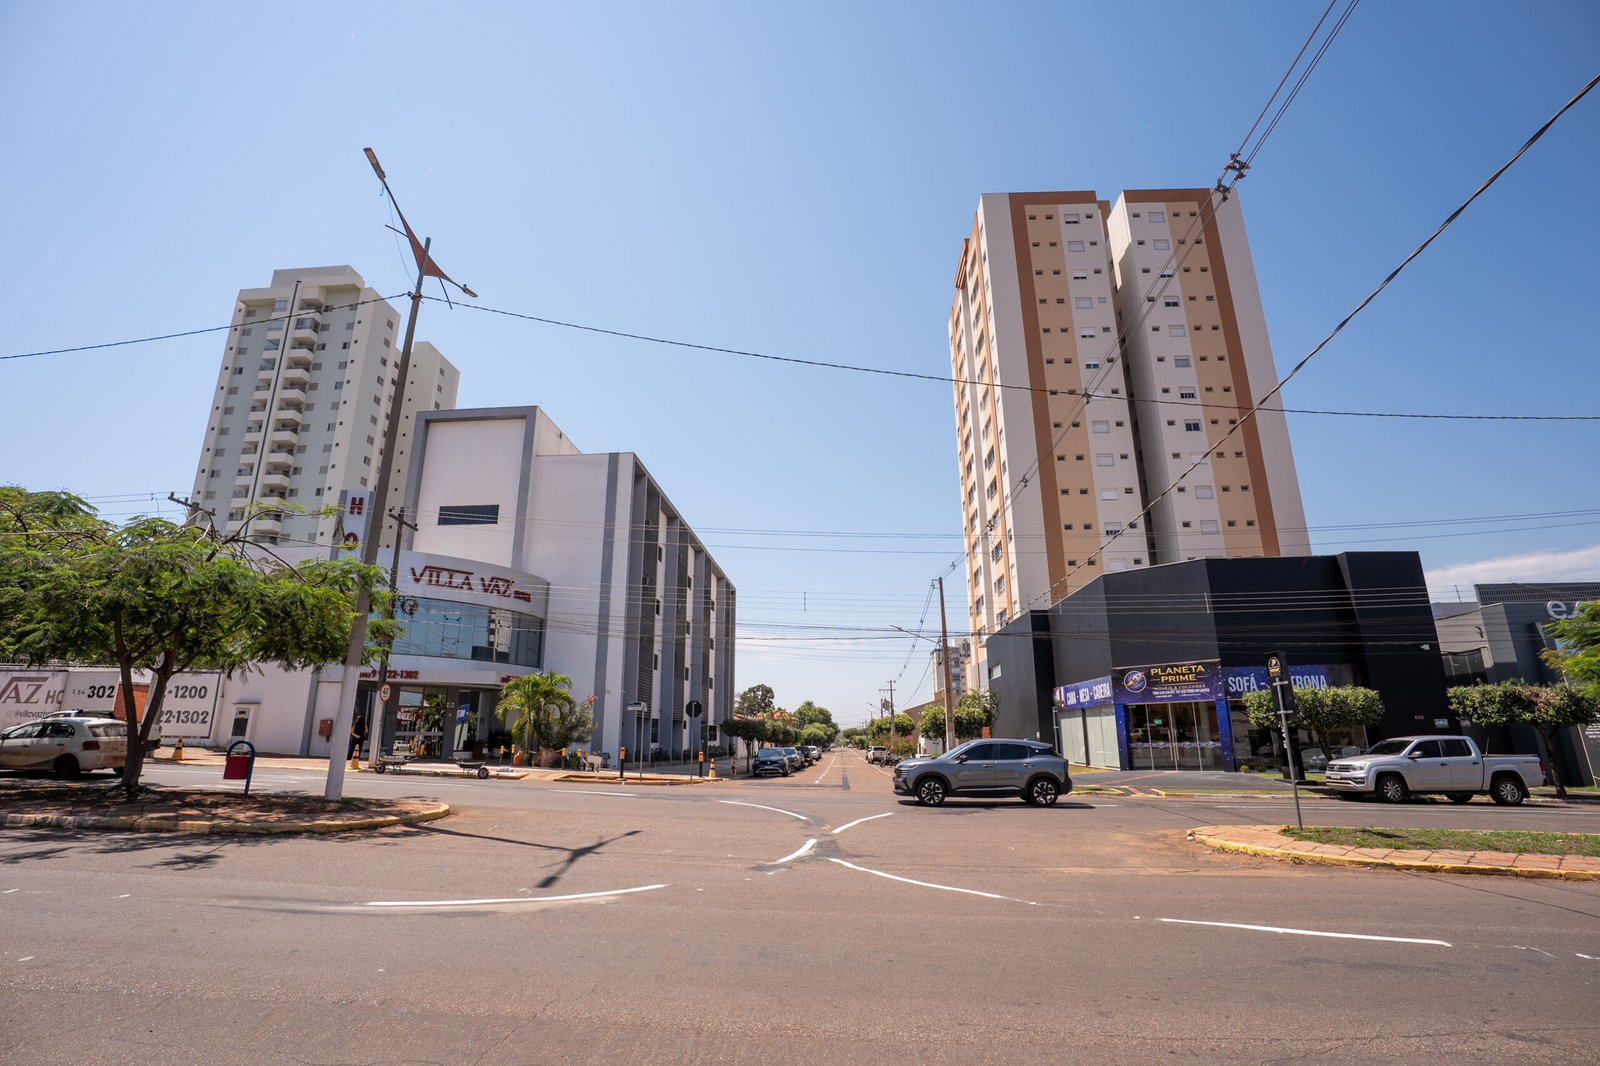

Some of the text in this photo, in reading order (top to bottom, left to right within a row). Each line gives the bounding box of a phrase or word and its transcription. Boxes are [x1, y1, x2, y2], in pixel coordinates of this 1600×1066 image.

[410, 565, 475, 591] VILLA
[480, 576, 515, 598] VAZ
[1150, 664, 1205, 676] PLANETA
[1161, 673, 1197, 683] PRIME
[1228, 673, 1259, 692] SOFÁ
[163, 685, 208, 699] -1200
